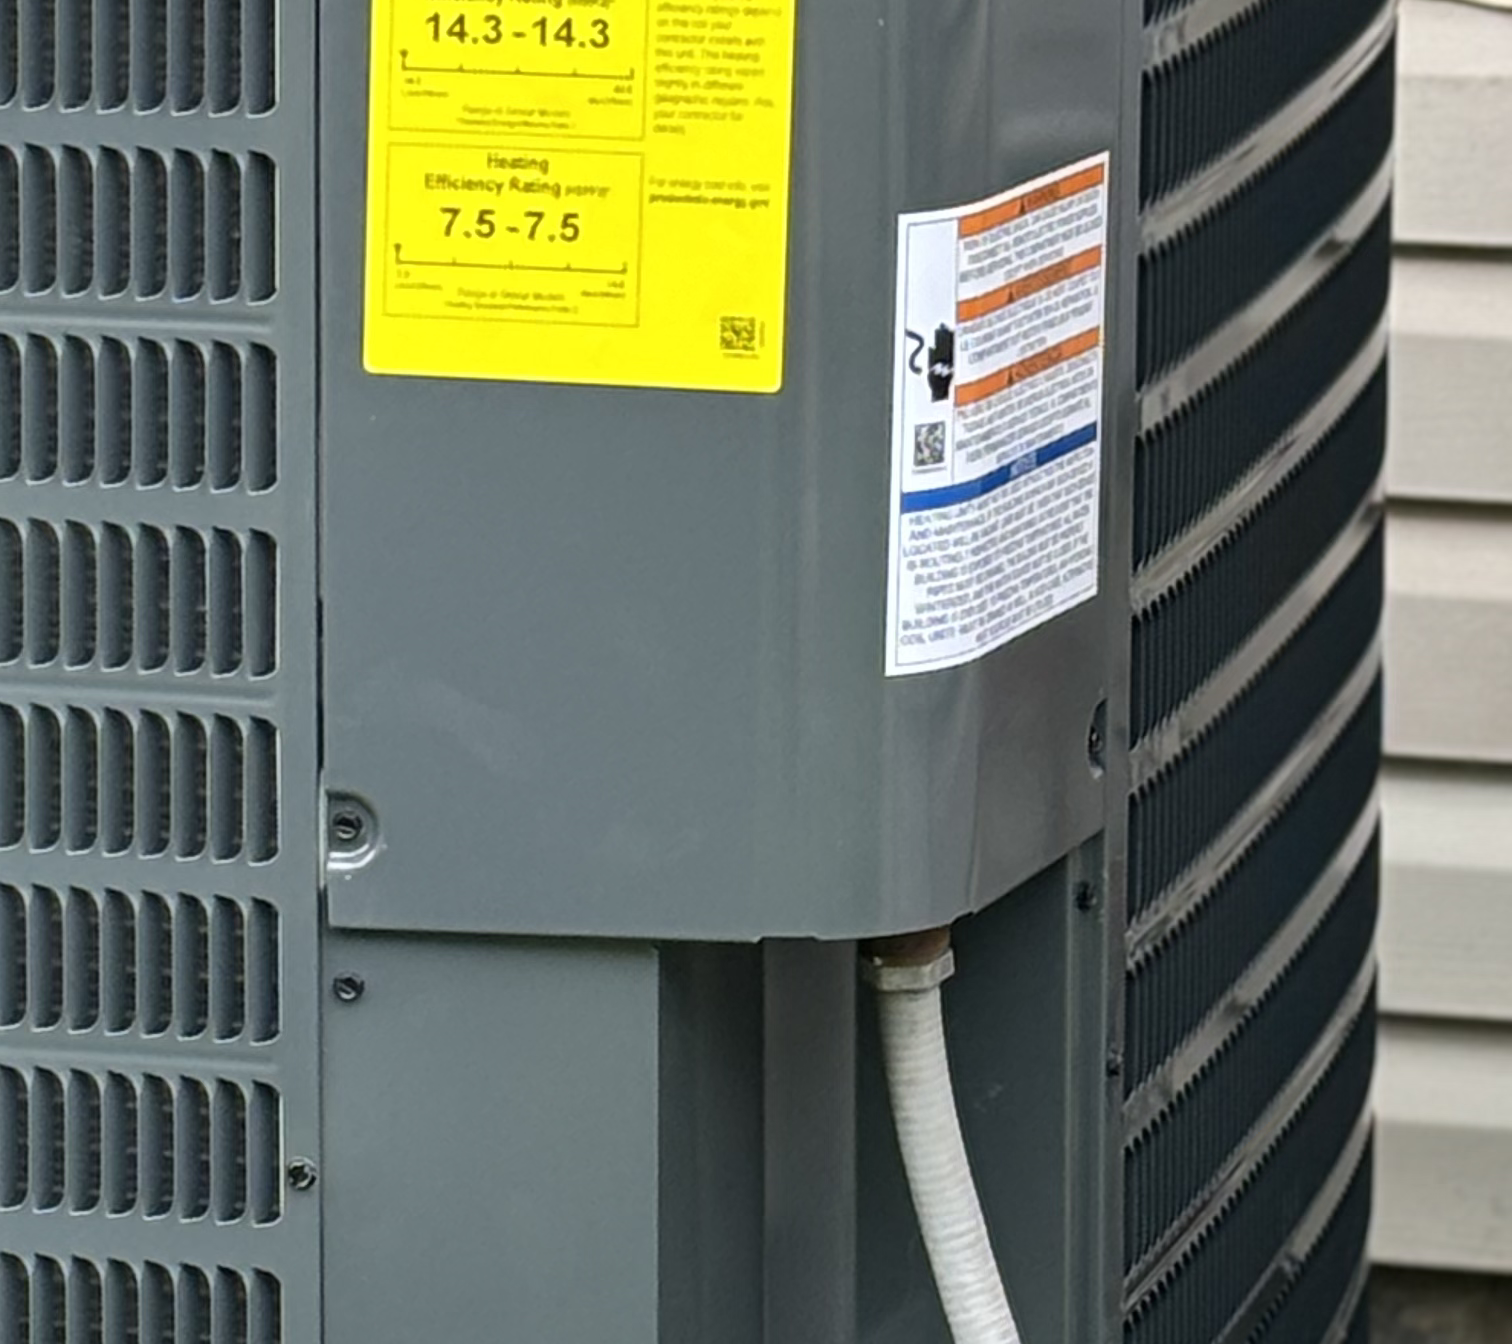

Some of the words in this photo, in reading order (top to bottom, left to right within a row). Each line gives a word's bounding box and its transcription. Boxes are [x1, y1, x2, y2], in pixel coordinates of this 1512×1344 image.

[425, 12, 502, 44] 14.3
[531, 16, 610, 49] 14.3
[487, 153, 549, 175] Heating
[424, 173, 504, 196] Efficiency
[509, 176, 561, 199] Rating
[439, 207, 496, 239] 7.5
[524, 211, 580, 243] 7.5
